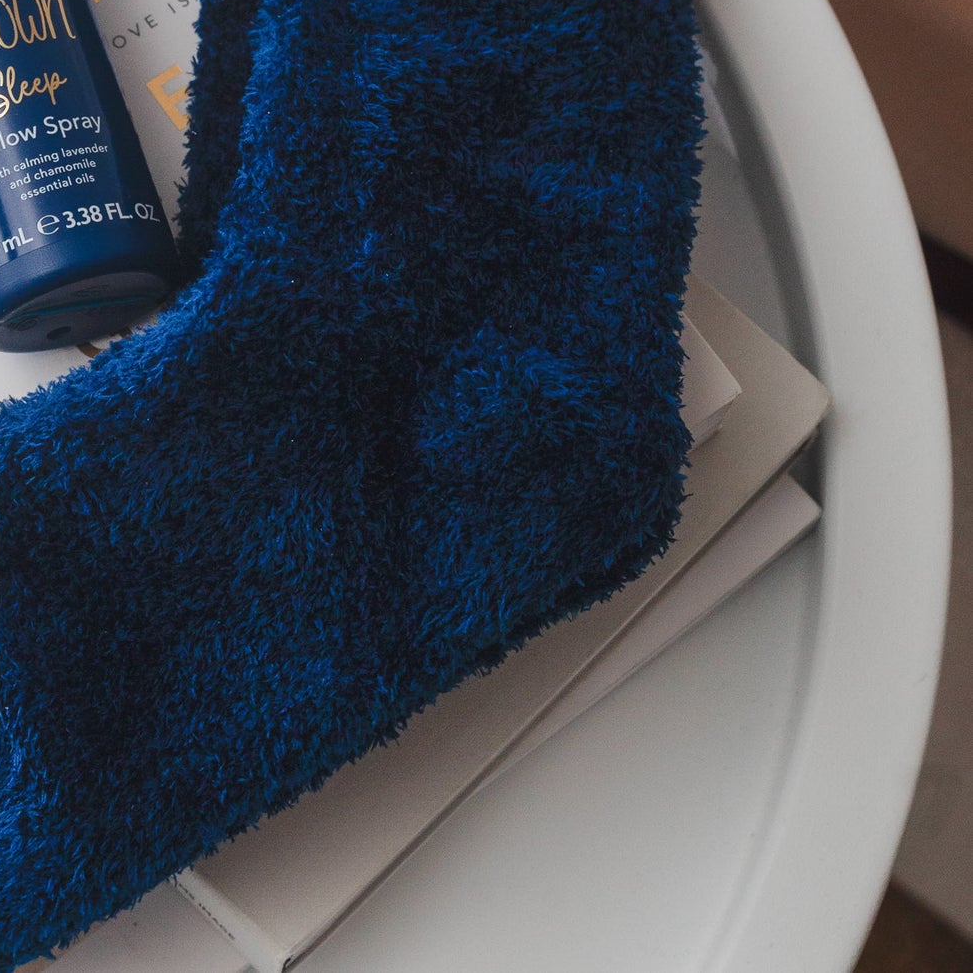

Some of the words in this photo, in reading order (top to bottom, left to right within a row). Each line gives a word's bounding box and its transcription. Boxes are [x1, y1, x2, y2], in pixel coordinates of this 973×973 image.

[111, 13, 159, 50] OVE
[43, 113, 102, 139] Spray
[13, 151, 60, 174] calming
[61, 142, 109, 159] lavender
[9, 171, 32, 191] and
[34, 158, 97, 181] chamomile
[20, 176, 73, 202] essential
[75, 172, 96, 186] oils
[2, 226, 34, 254] mL
[62, 204, 103, 230] 3.38
[105, 201, 134, 222] FL.
